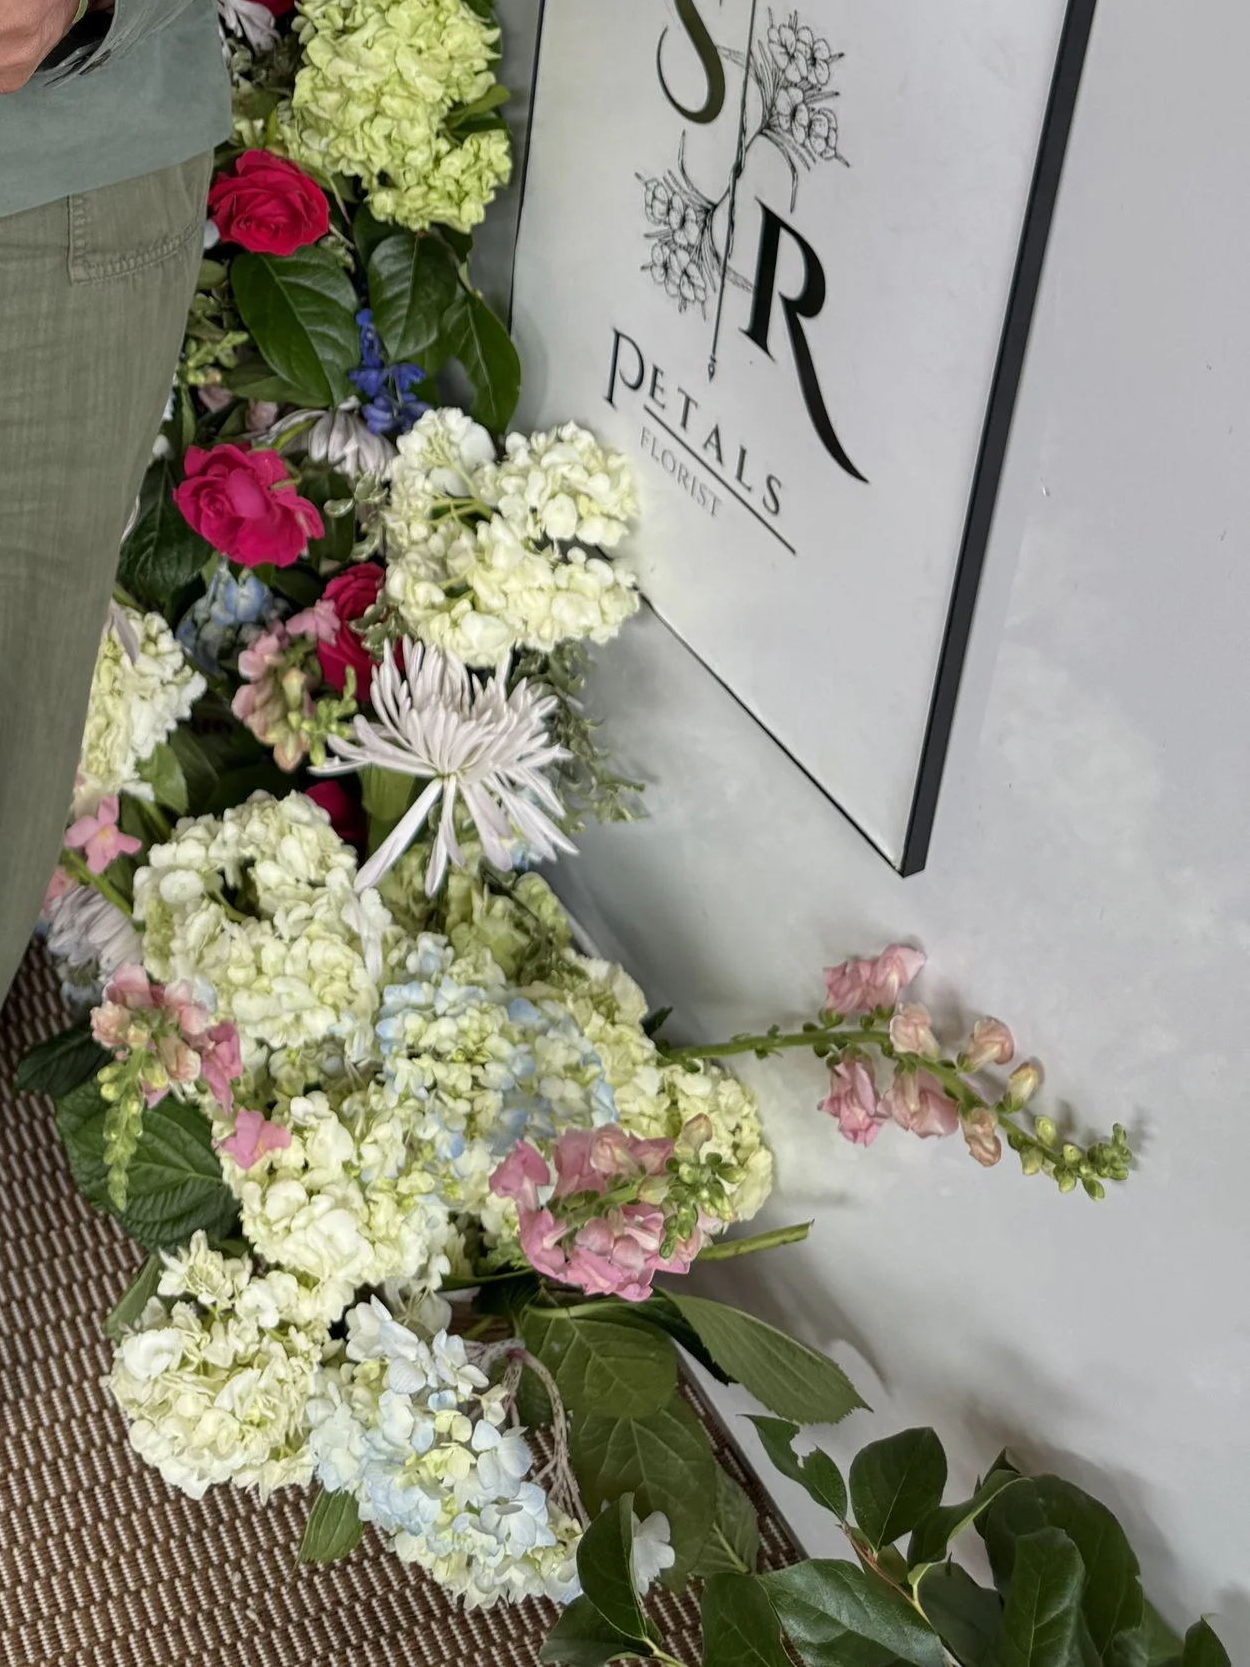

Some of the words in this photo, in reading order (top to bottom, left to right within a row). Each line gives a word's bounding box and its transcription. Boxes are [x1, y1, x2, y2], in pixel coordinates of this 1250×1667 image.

[604, 326, 782, 516] PETALS
[738, 196, 870, 485] R
[640, 425, 723, 518] FLORIST
